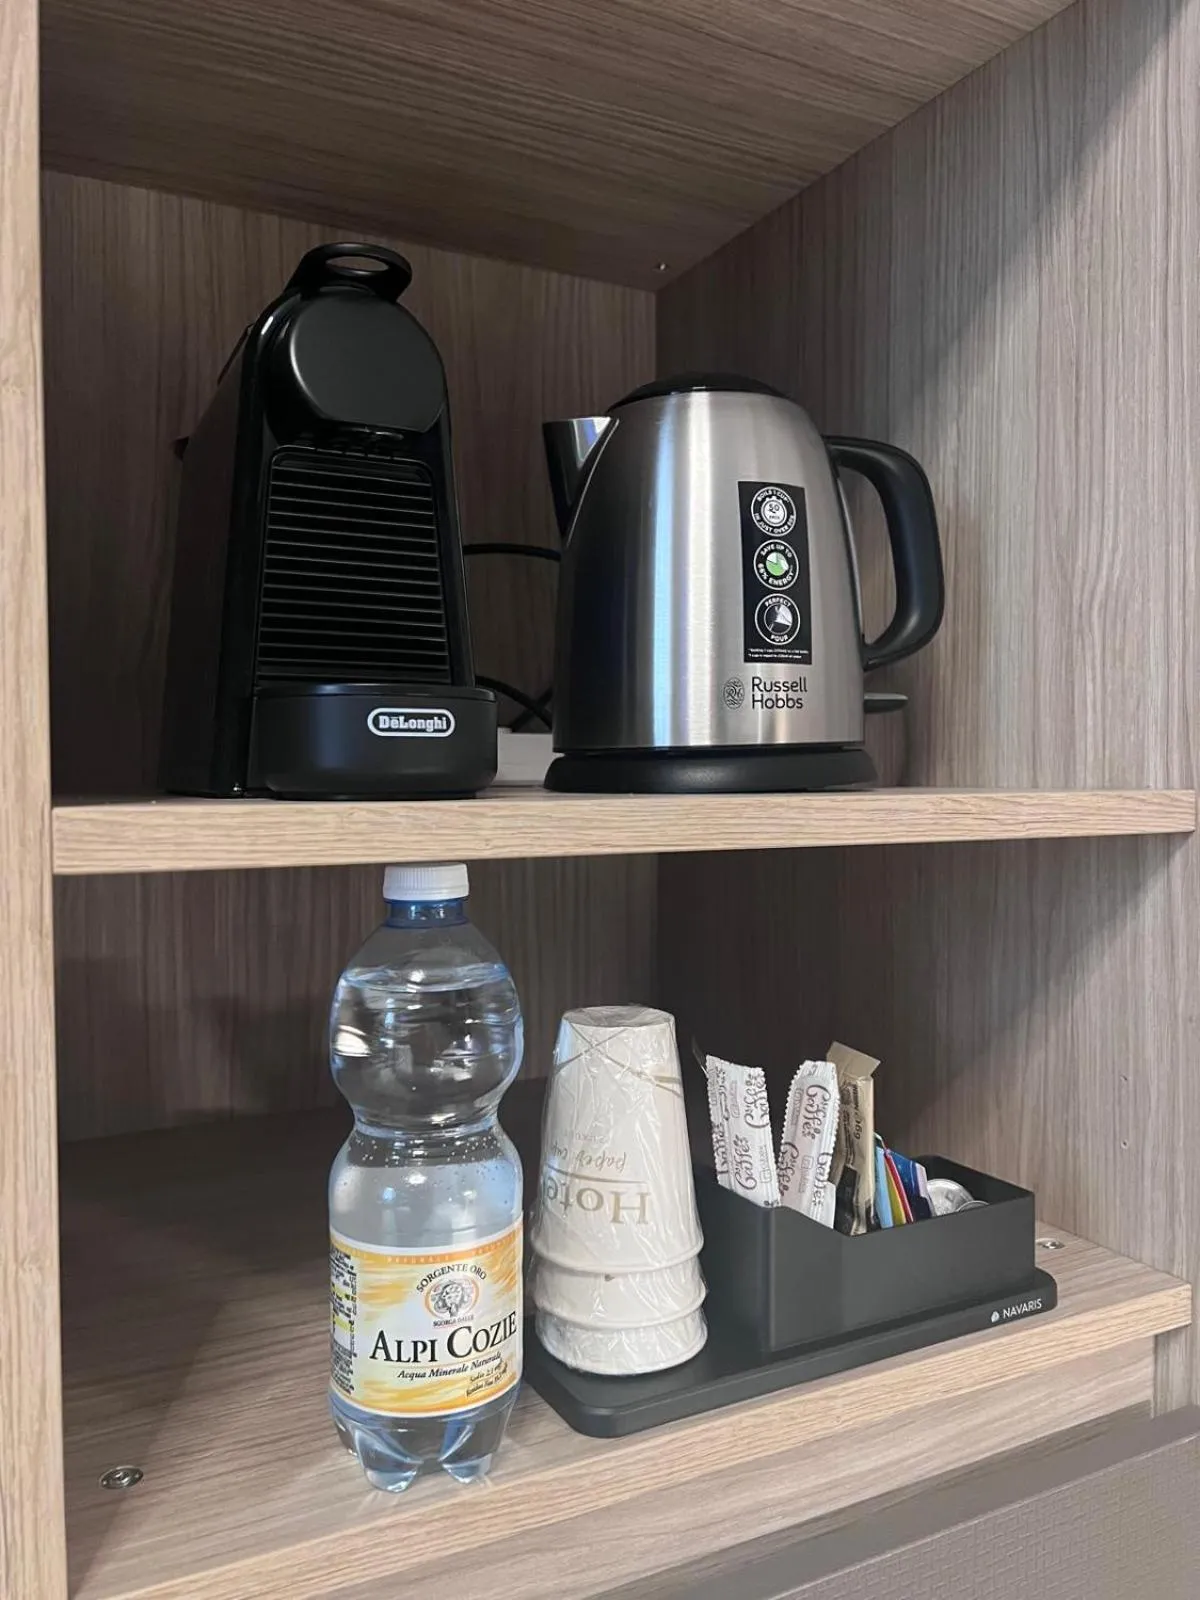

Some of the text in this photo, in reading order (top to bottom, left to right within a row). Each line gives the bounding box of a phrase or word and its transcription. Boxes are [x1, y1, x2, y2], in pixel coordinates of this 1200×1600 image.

[759, 520, 773, 532] JUST
[773, 525, 789, 534] OVER
[785, 548, 792, 558] TO
[764, 597, 791, 607] PERFECT
[771, 634, 788, 642] POUR
[751, 676, 808, 693] Russell
[752, 693, 803, 709] Hobbs
[416, 1263, 488, 1292] SORGENTE ORO
[1003, 1298, 1042, 1319] NAVARIS
[369, 1311, 517, 1363] ALPI COZIE
[397, 1369, 427, 1380] Acqua
[428, 1363, 469, 1377] Minerale
